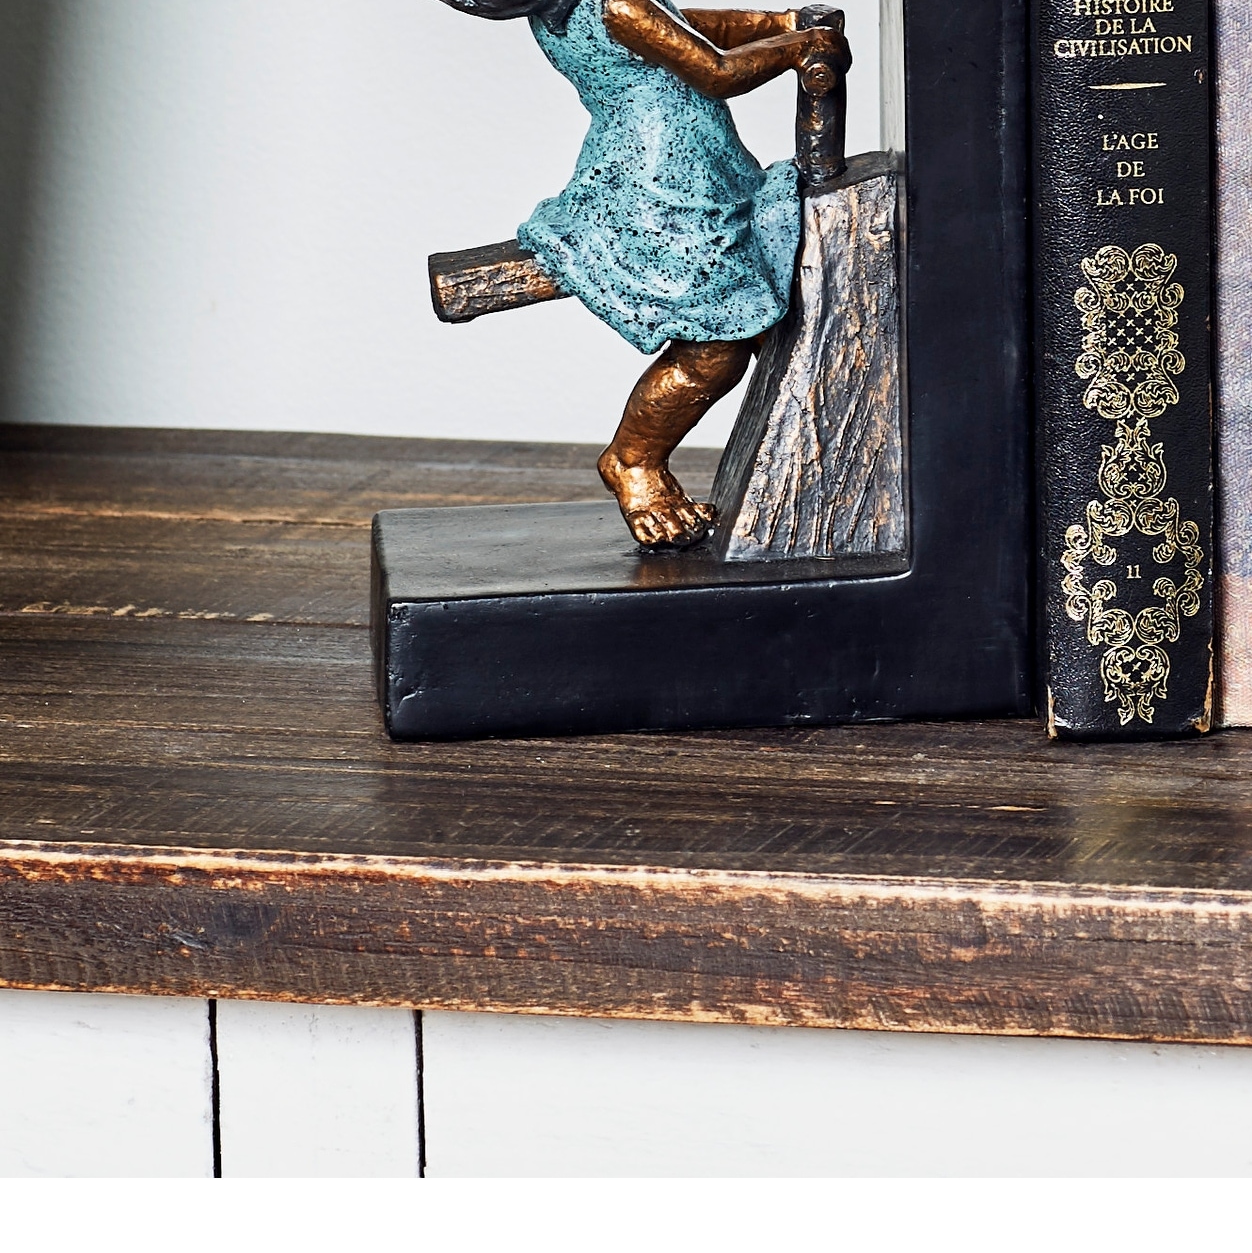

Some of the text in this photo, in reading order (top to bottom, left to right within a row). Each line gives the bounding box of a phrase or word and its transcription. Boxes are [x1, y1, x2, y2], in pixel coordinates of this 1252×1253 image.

[1095, 17, 1156, 36] DE LA
[1053, 35, 1192, 57] CIVILISATION
[1102, 132, 1159, 151] L'AGE
[1116, 161, 1146, 178] DE
[1096, 187, 1165, 206] LA FOI
[1126, 564, 1142, 579] 11
